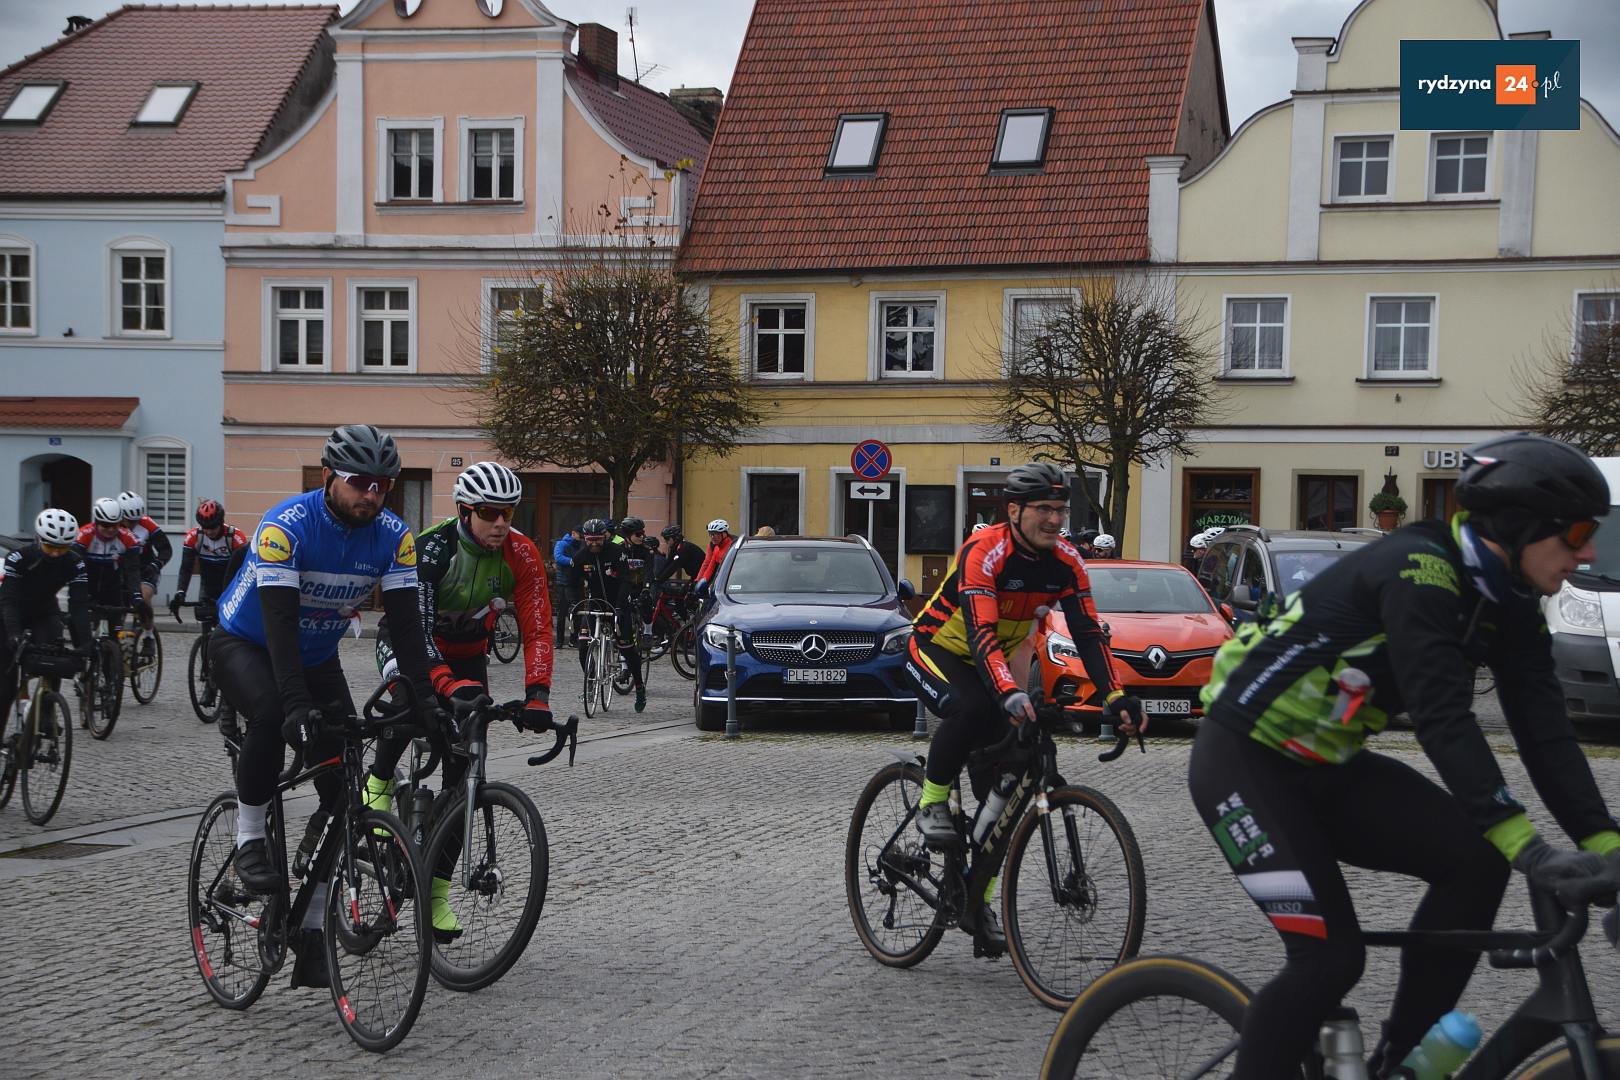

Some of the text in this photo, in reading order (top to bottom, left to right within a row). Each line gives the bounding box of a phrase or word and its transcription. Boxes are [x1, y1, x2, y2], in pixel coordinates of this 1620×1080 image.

[452, 458, 461, 466] 25
[278, 503, 307, 526] PRO
[1196, 514, 1249, 527] WARZYWA
[376, 511, 402, 533] PRO
[789, 670, 810, 681] PLE
[813, 670, 846, 681] 31829
[1156, 701, 1189, 713] 19863
[980, 769, 1033, 854] TREK
